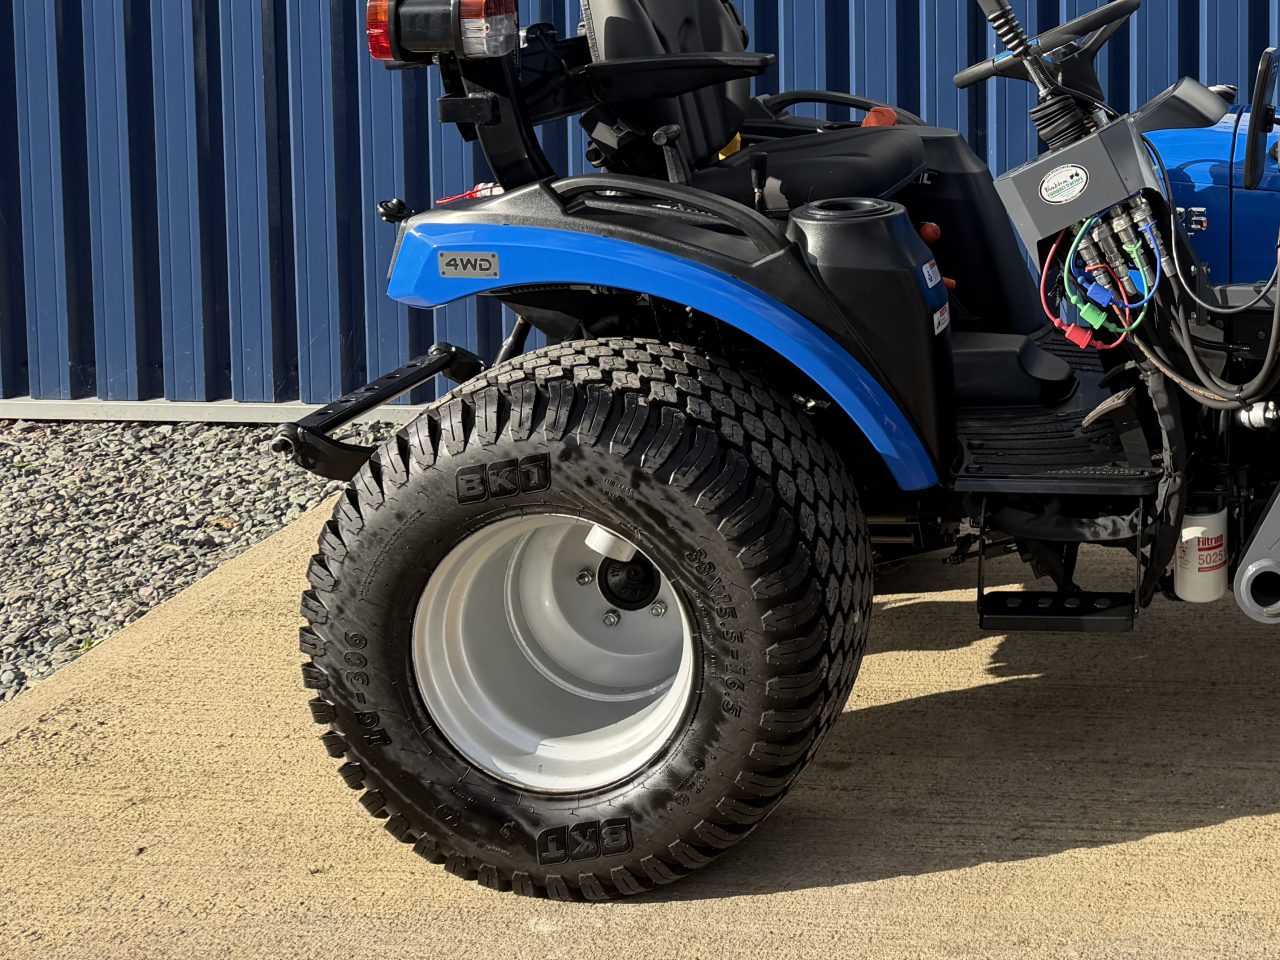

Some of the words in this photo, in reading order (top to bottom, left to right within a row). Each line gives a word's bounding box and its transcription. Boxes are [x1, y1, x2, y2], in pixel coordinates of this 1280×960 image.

[445, 257, 492, 271] 4WD
[456, 455, 550, 504] BKT
[536, 816, 632, 866] BKT
